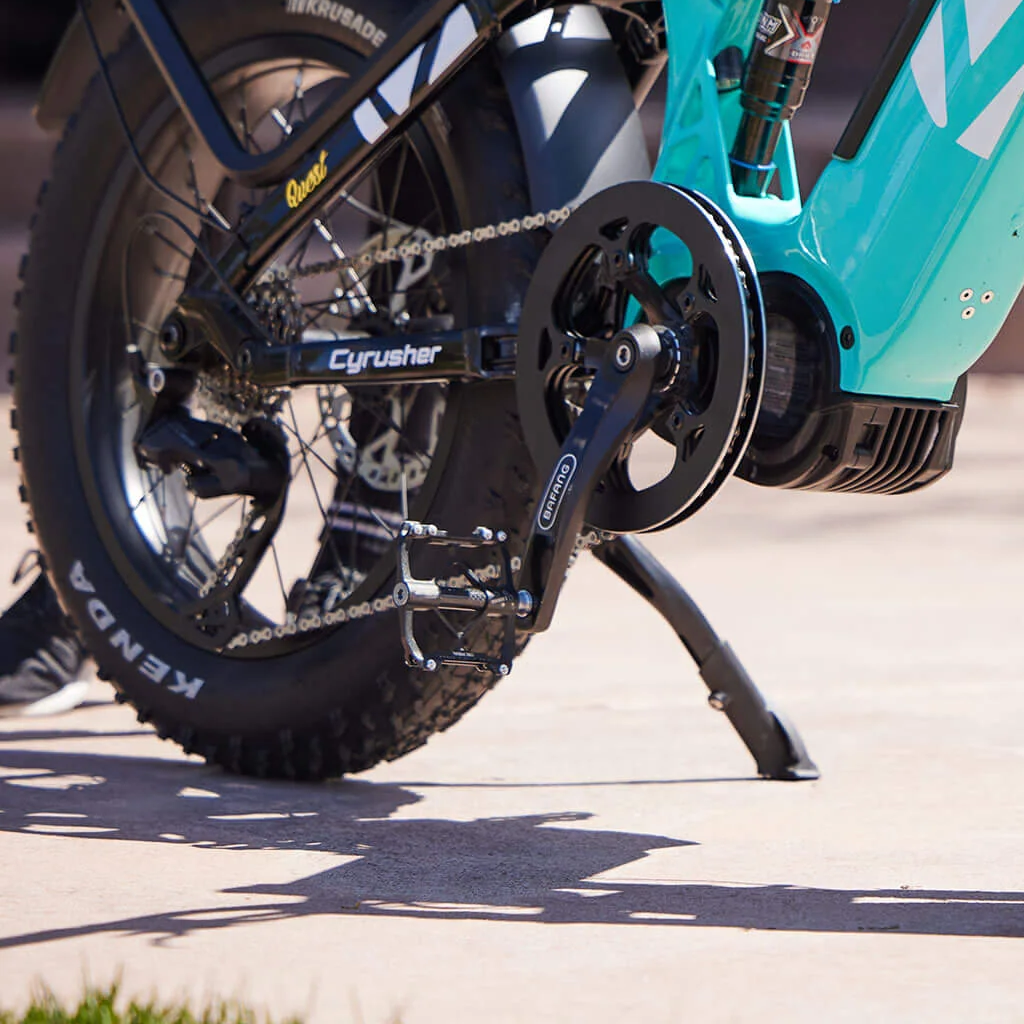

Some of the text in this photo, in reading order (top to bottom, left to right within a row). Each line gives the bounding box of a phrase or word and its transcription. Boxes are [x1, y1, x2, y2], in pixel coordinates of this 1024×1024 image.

[286, 149, 328, 208] Quest
[328, 343, 443, 375] Cyrusher
[543, 464, 570, 521] BAFANG
[69, 559, 205, 700] KENDA
